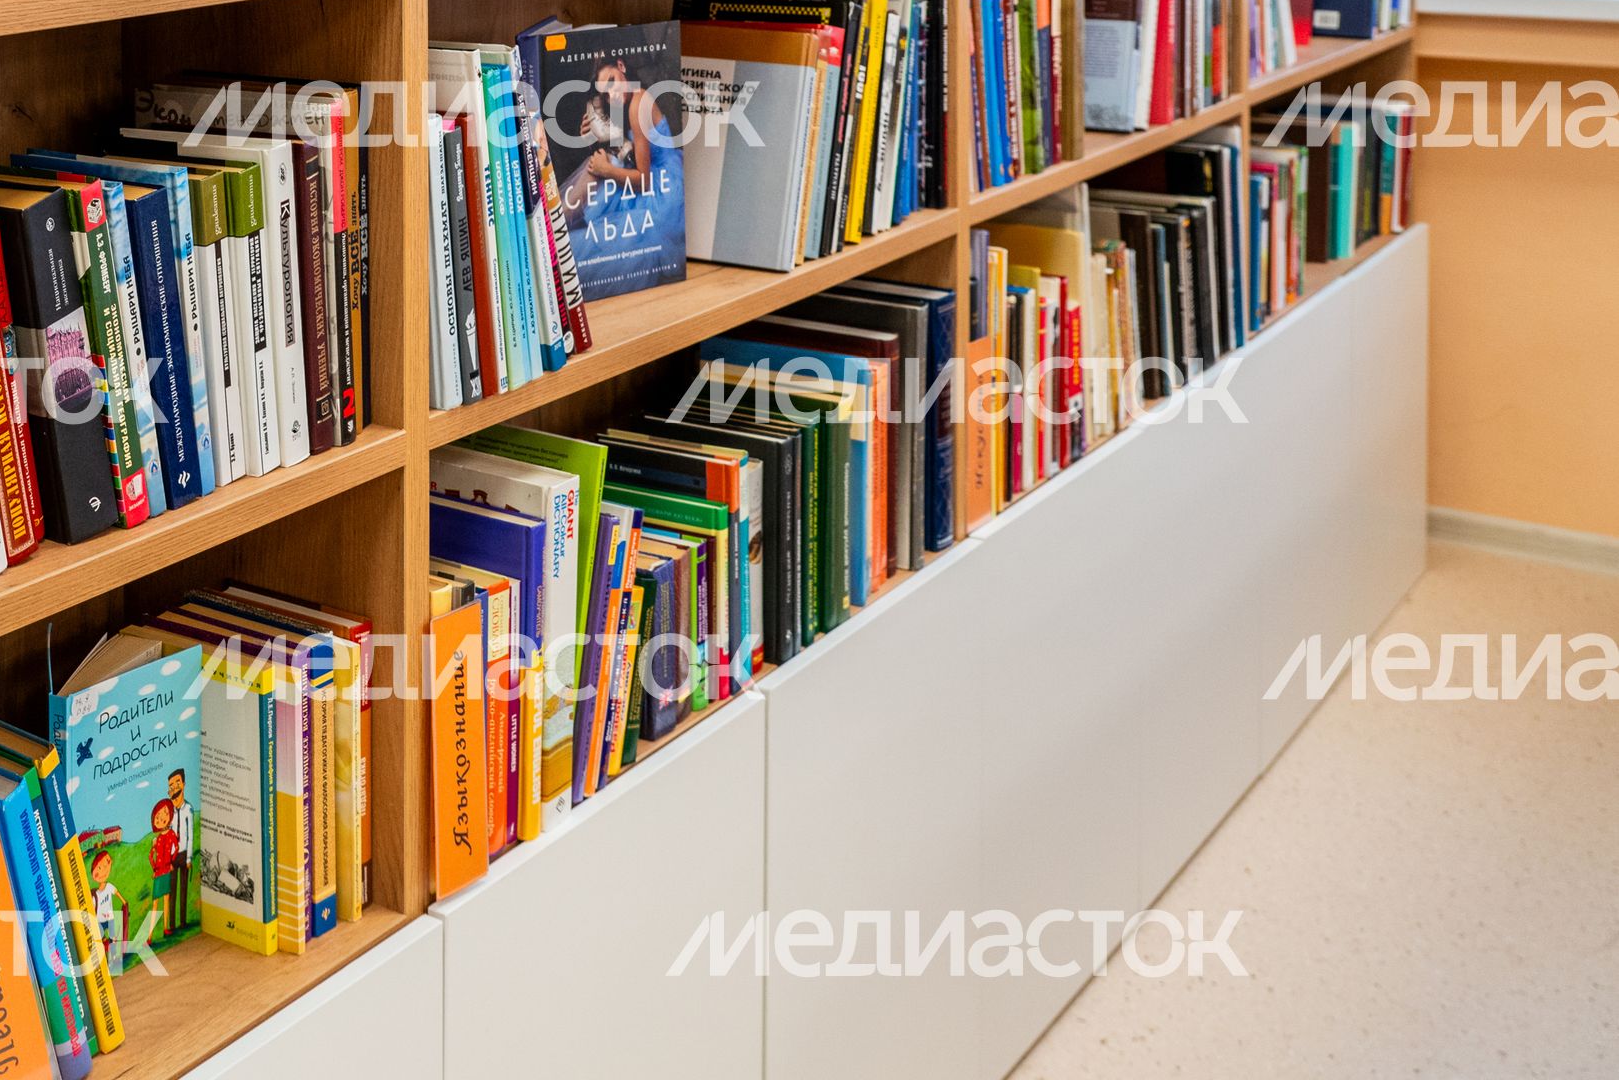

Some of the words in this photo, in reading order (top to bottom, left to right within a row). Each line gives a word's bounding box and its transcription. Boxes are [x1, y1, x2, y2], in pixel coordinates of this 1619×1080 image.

[560, 50, 605, 63] АДЕЛИНА
[612, 42, 667, 57] СОТНИКОВА
[566, 170, 671, 210] СЕРДЦЕ
[585, 217, 655, 242] ЛЬДА
[566, 488, 574, 541] GIANT
[453, 649, 472, 856] Языкознание
